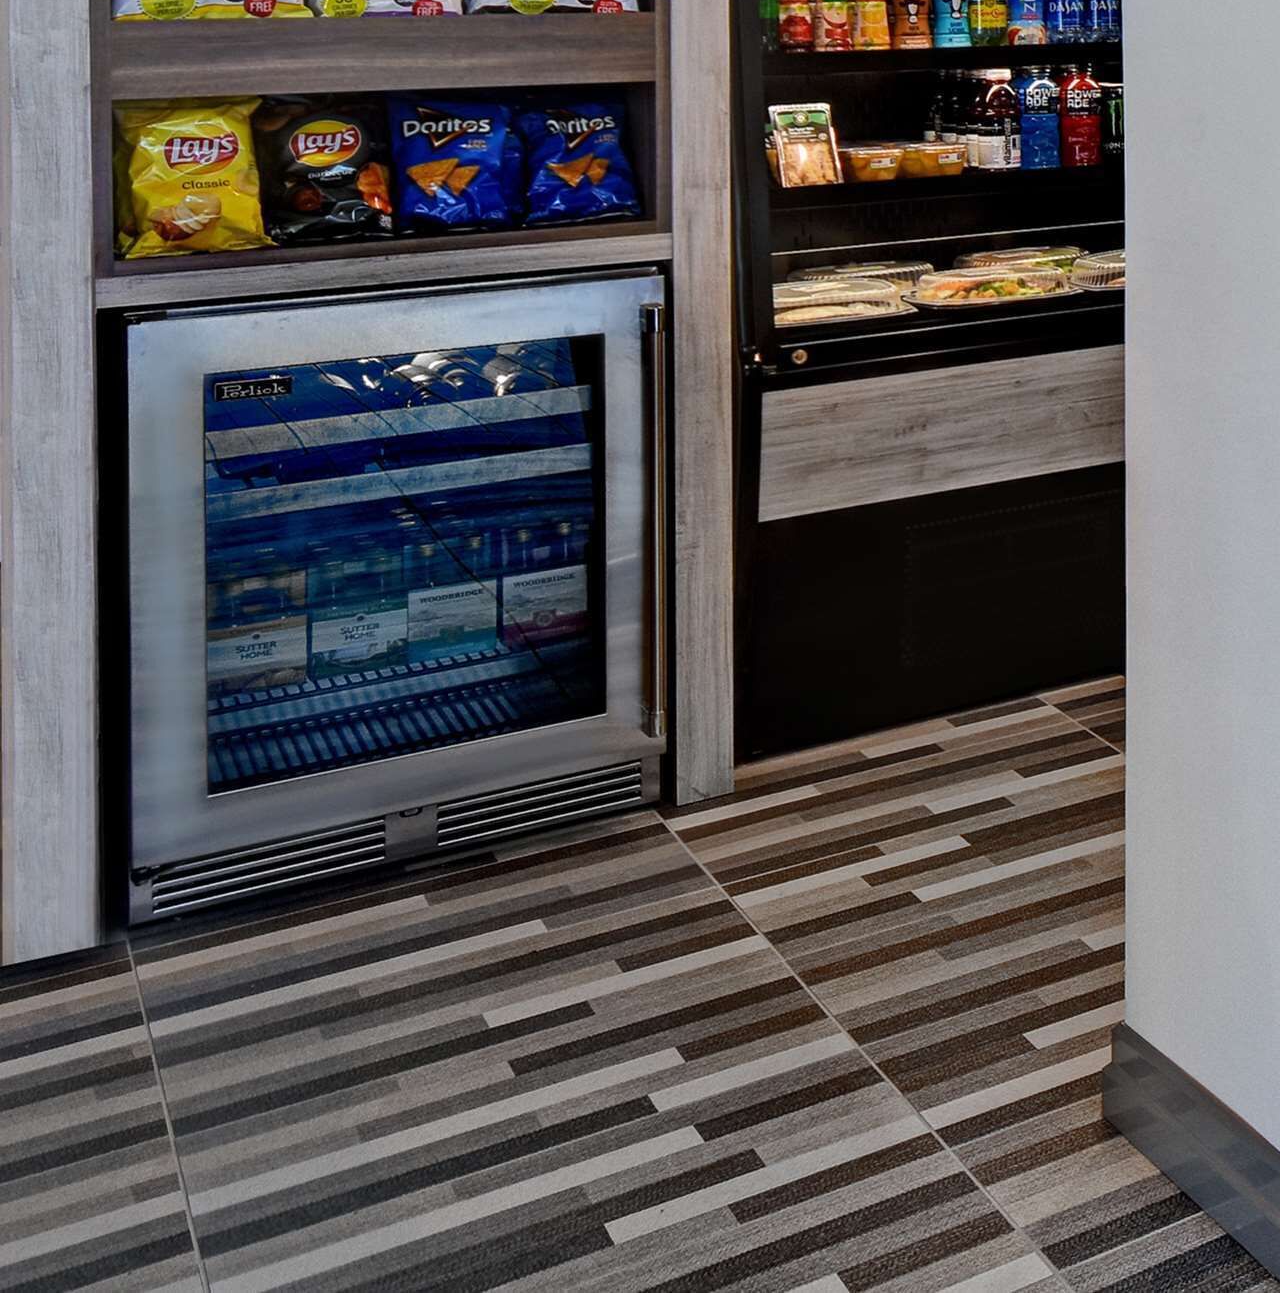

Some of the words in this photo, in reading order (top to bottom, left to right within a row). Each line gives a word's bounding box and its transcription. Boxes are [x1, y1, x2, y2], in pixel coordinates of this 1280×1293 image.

[249, 1, 273, 13] FREE
[1026, 88, 1060, 98] POWE
[1067, 88, 1101, 99] POWE
[403, 118, 491, 137] Doritos
[546, 116, 615, 134] Doritos
[297, 130, 355, 154] Lay's
[170, 134, 235, 164] Lay's
[182, 178, 231, 190] Classic
[221, 383, 287, 399] Perlick
[513, 573, 576, 588] WOODBRIDGE
[420, 589, 484, 604] WOODBRIDGE
[339, 623, 379, 635] SUTTER
[344, 632, 377, 641] HOME
[235, 641, 277, 654] SUTTER
[240, 649, 273, 660] HOME
